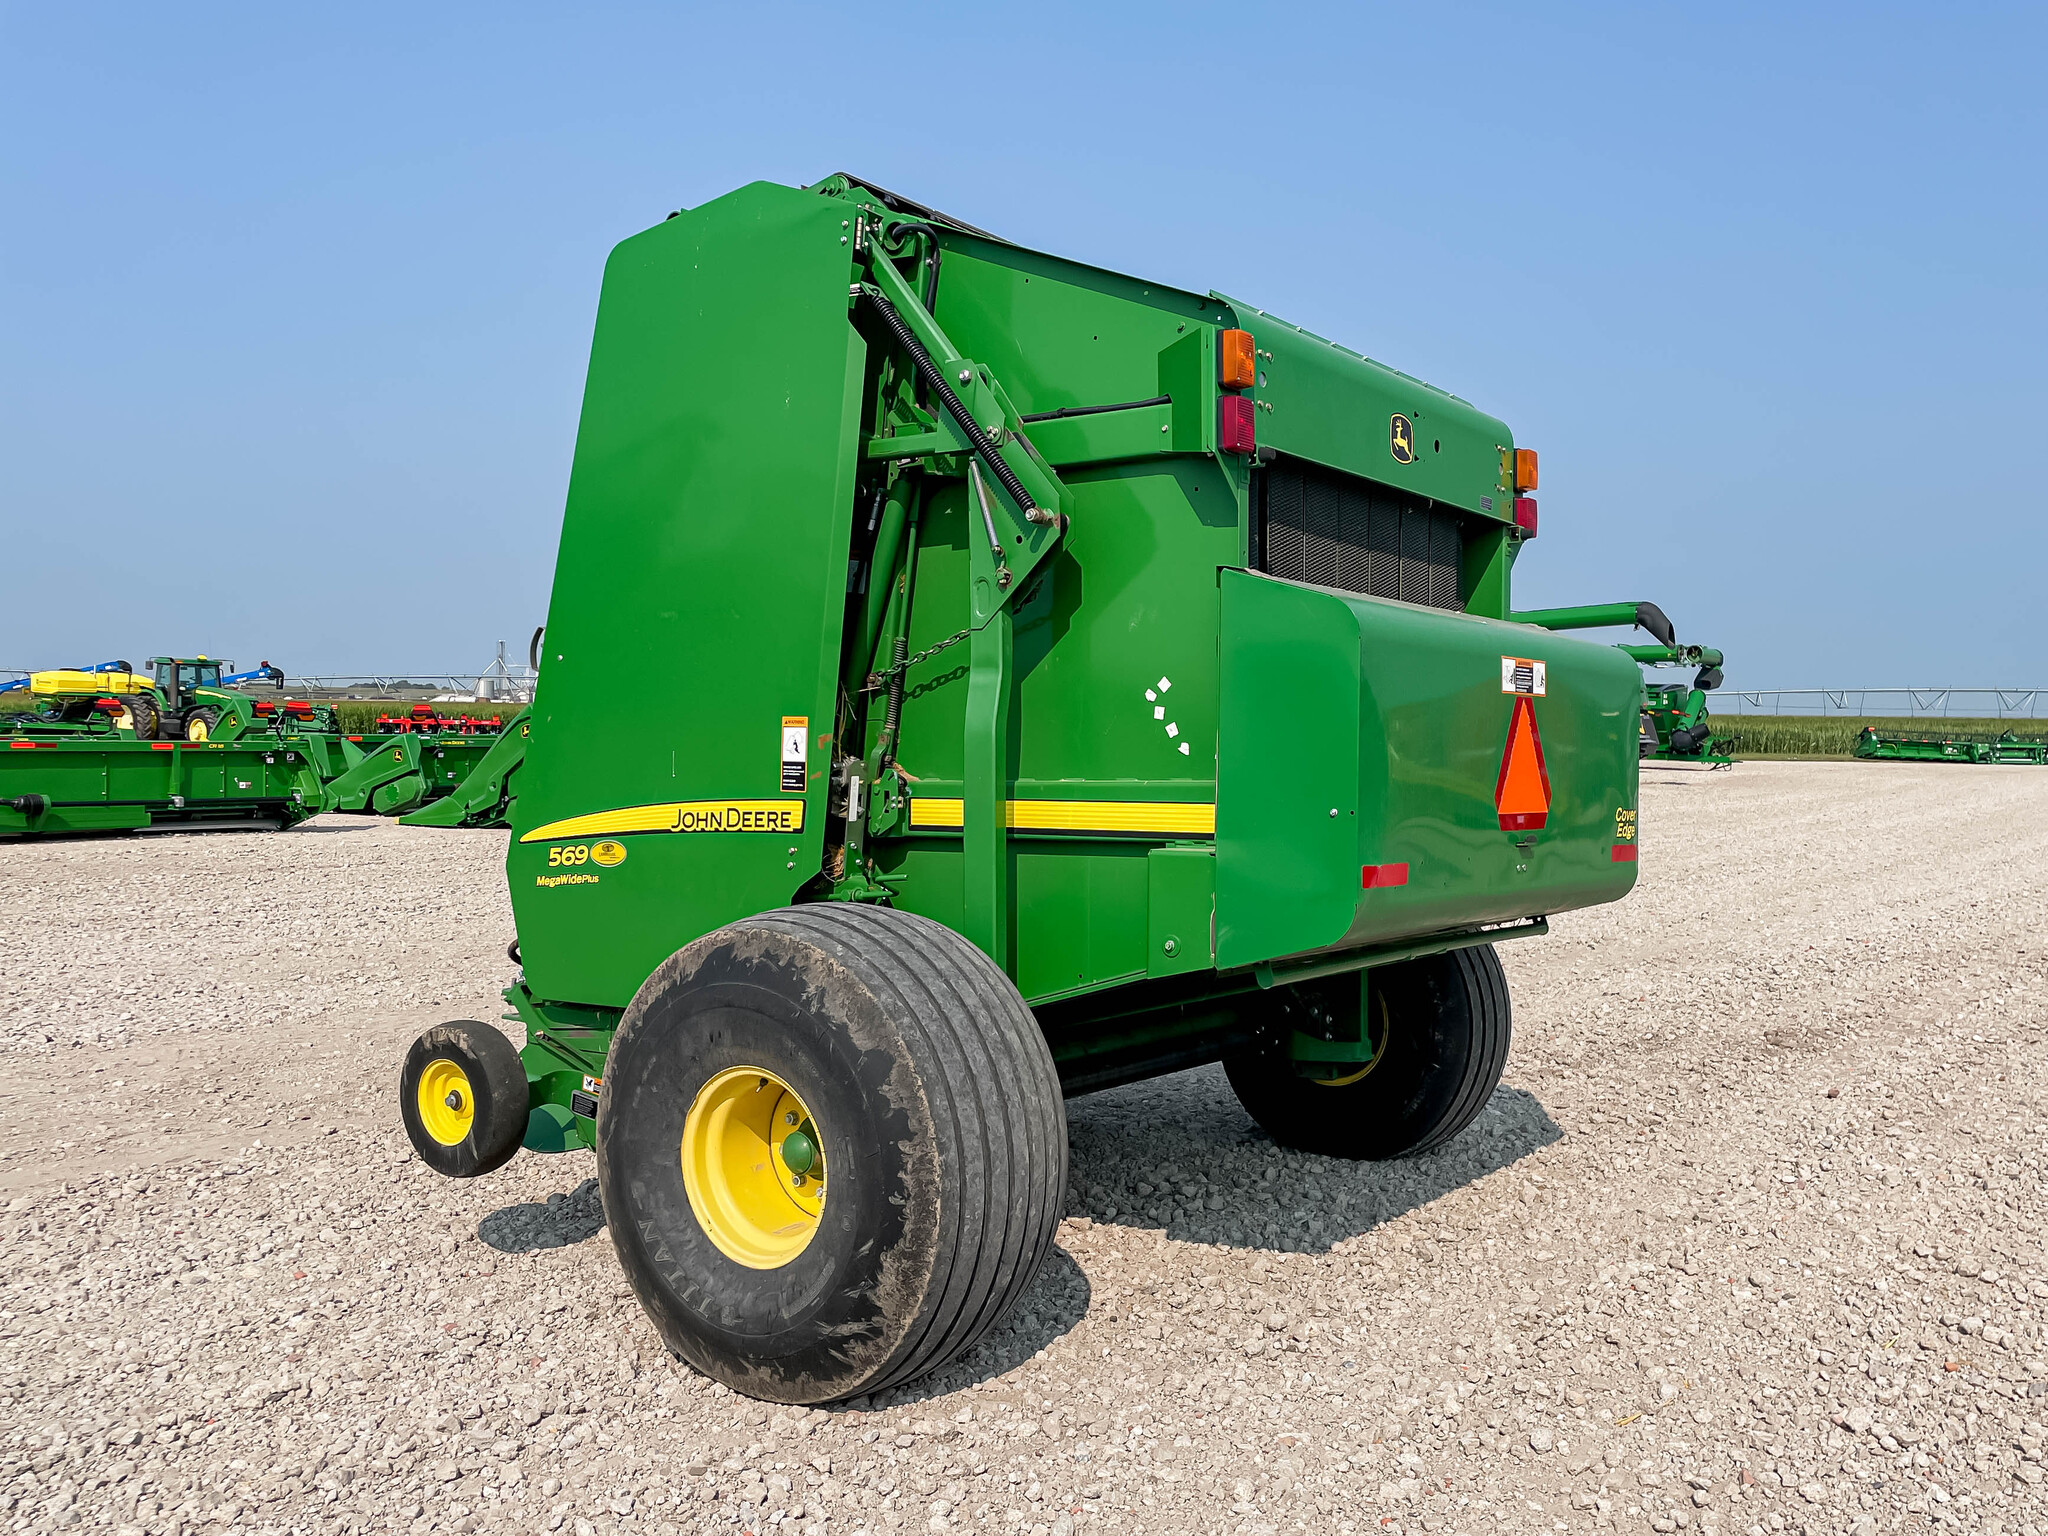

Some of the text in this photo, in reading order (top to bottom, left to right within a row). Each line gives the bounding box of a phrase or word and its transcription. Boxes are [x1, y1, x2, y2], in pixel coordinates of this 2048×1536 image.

[671, 808, 791, 829] JOHN DEERE
[1615, 806, 1636, 822] Cover
[1616, 822, 1635, 840] Edge
[548, 845, 589, 867] 569
[537, 873, 599, 888] MegaWidePlus
[638, 1220, 714, 1319] TITAN
